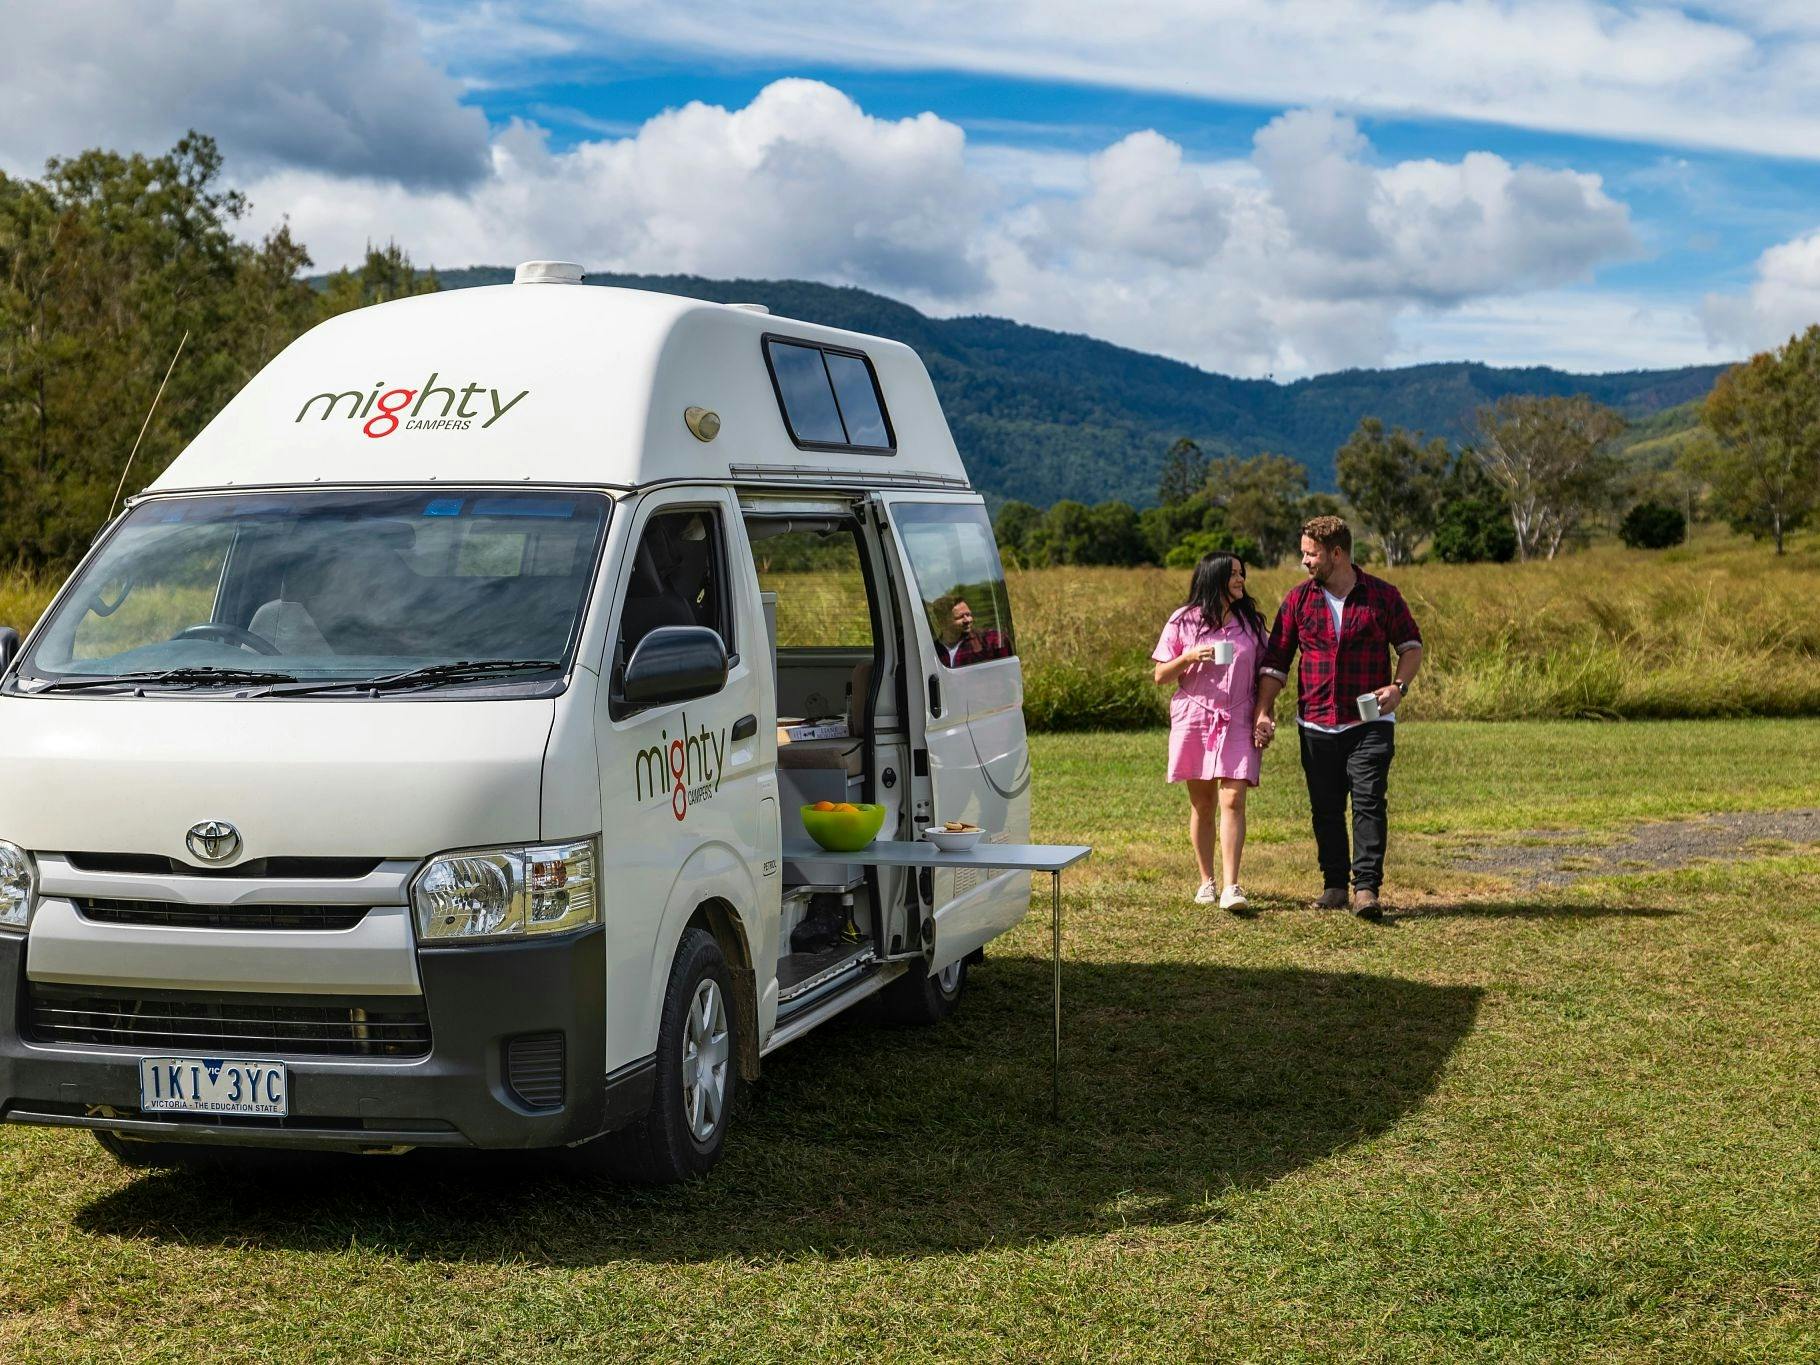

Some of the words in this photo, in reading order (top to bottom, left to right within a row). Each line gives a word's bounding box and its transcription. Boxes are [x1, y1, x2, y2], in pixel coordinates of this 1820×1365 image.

[295, 372, 530, 438] mighty
[405, 419, 472, 430] CAMPERS
[636, 711, 725, 821] mighty
[687, 784, 713, 806] CAMPERS
[207, 1067, 220, 1075] VIC
[151, 1065, 200, 1100] 1KI
[227, 1068, 281, 1103] 3YC
[151, 1100, 187, 1108] VICTORIA
[194, 1102, 209, 1110] THE
[211, 1103, 253, 1112] EDUCATION
[255, 1105, 278, 1113] STATE
